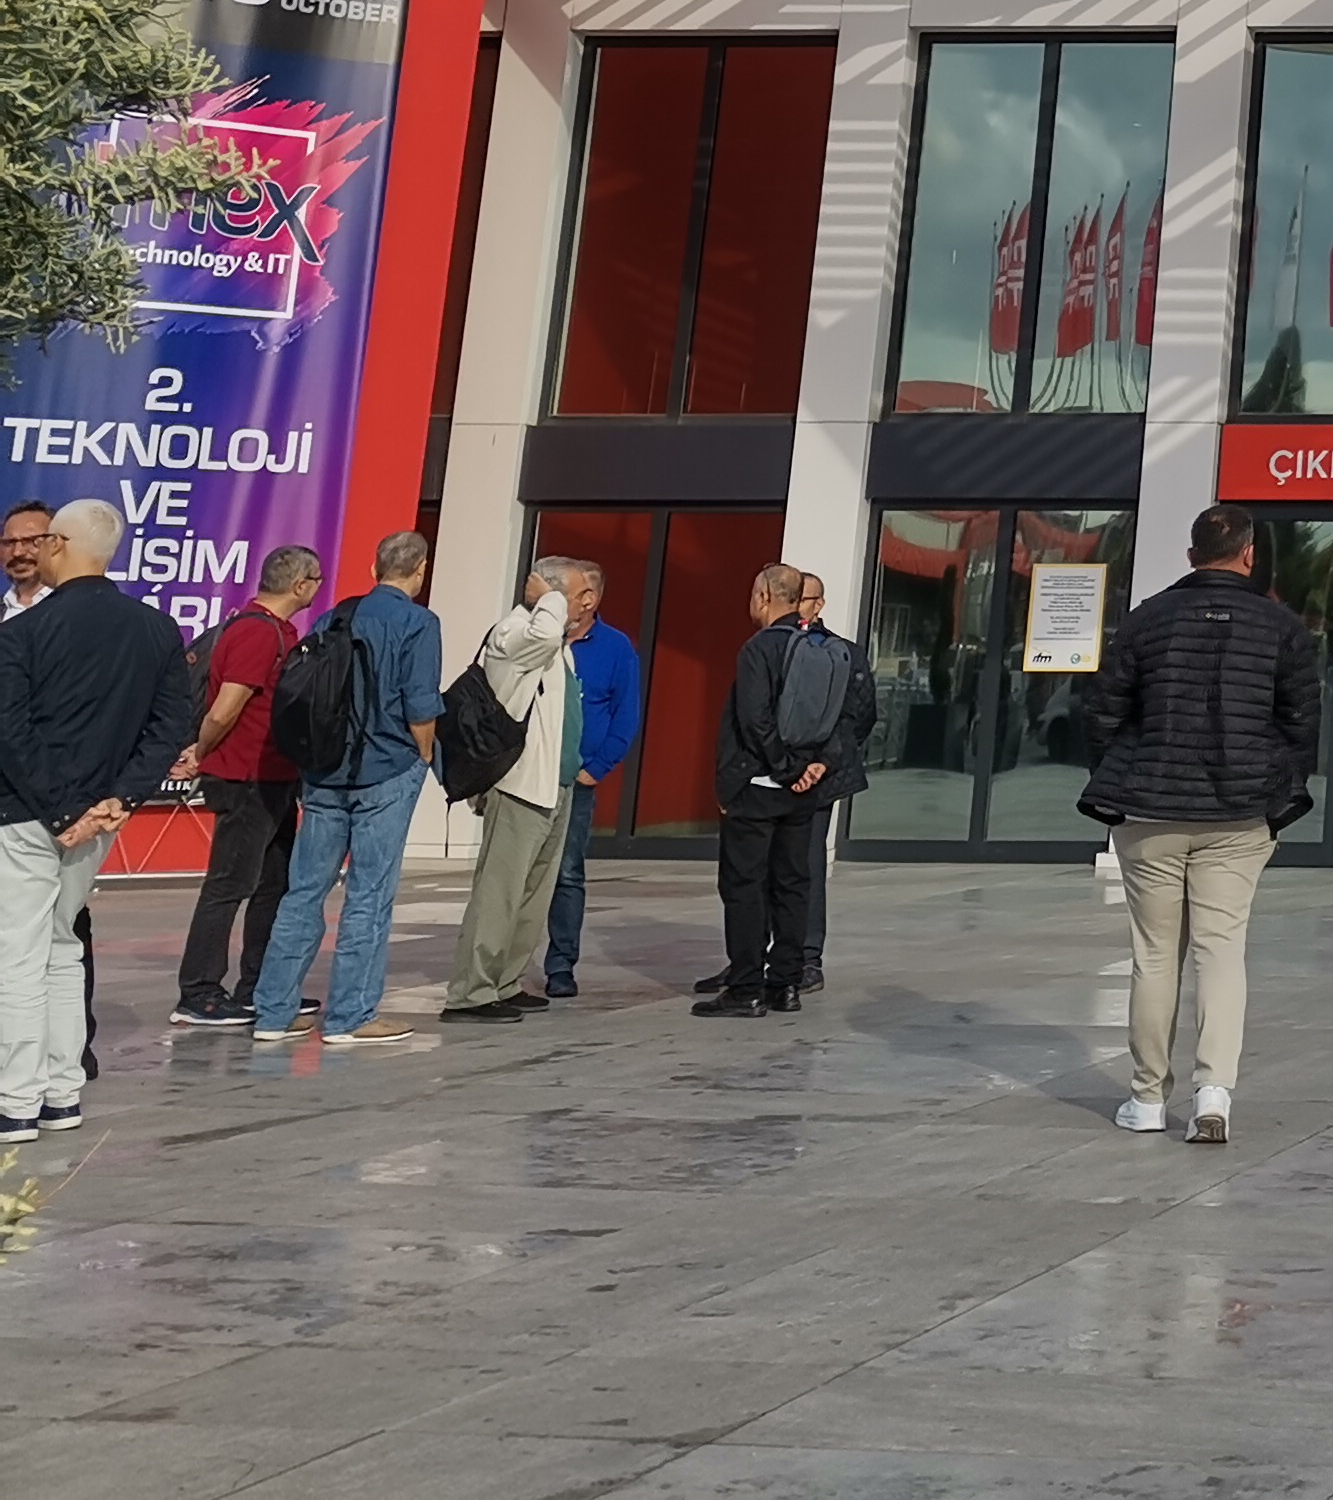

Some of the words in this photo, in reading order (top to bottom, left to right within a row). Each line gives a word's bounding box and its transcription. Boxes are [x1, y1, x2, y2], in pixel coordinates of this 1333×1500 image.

[130, 240, 242, 277] chnology
[244, 251, 264, 273] &
[267, 253, 291, 275] IT
[144, 367, 193, 413] 2.
[3, 417, 313, 474] TEKNOLOJİ
[119, 479, 192, 526] VE
